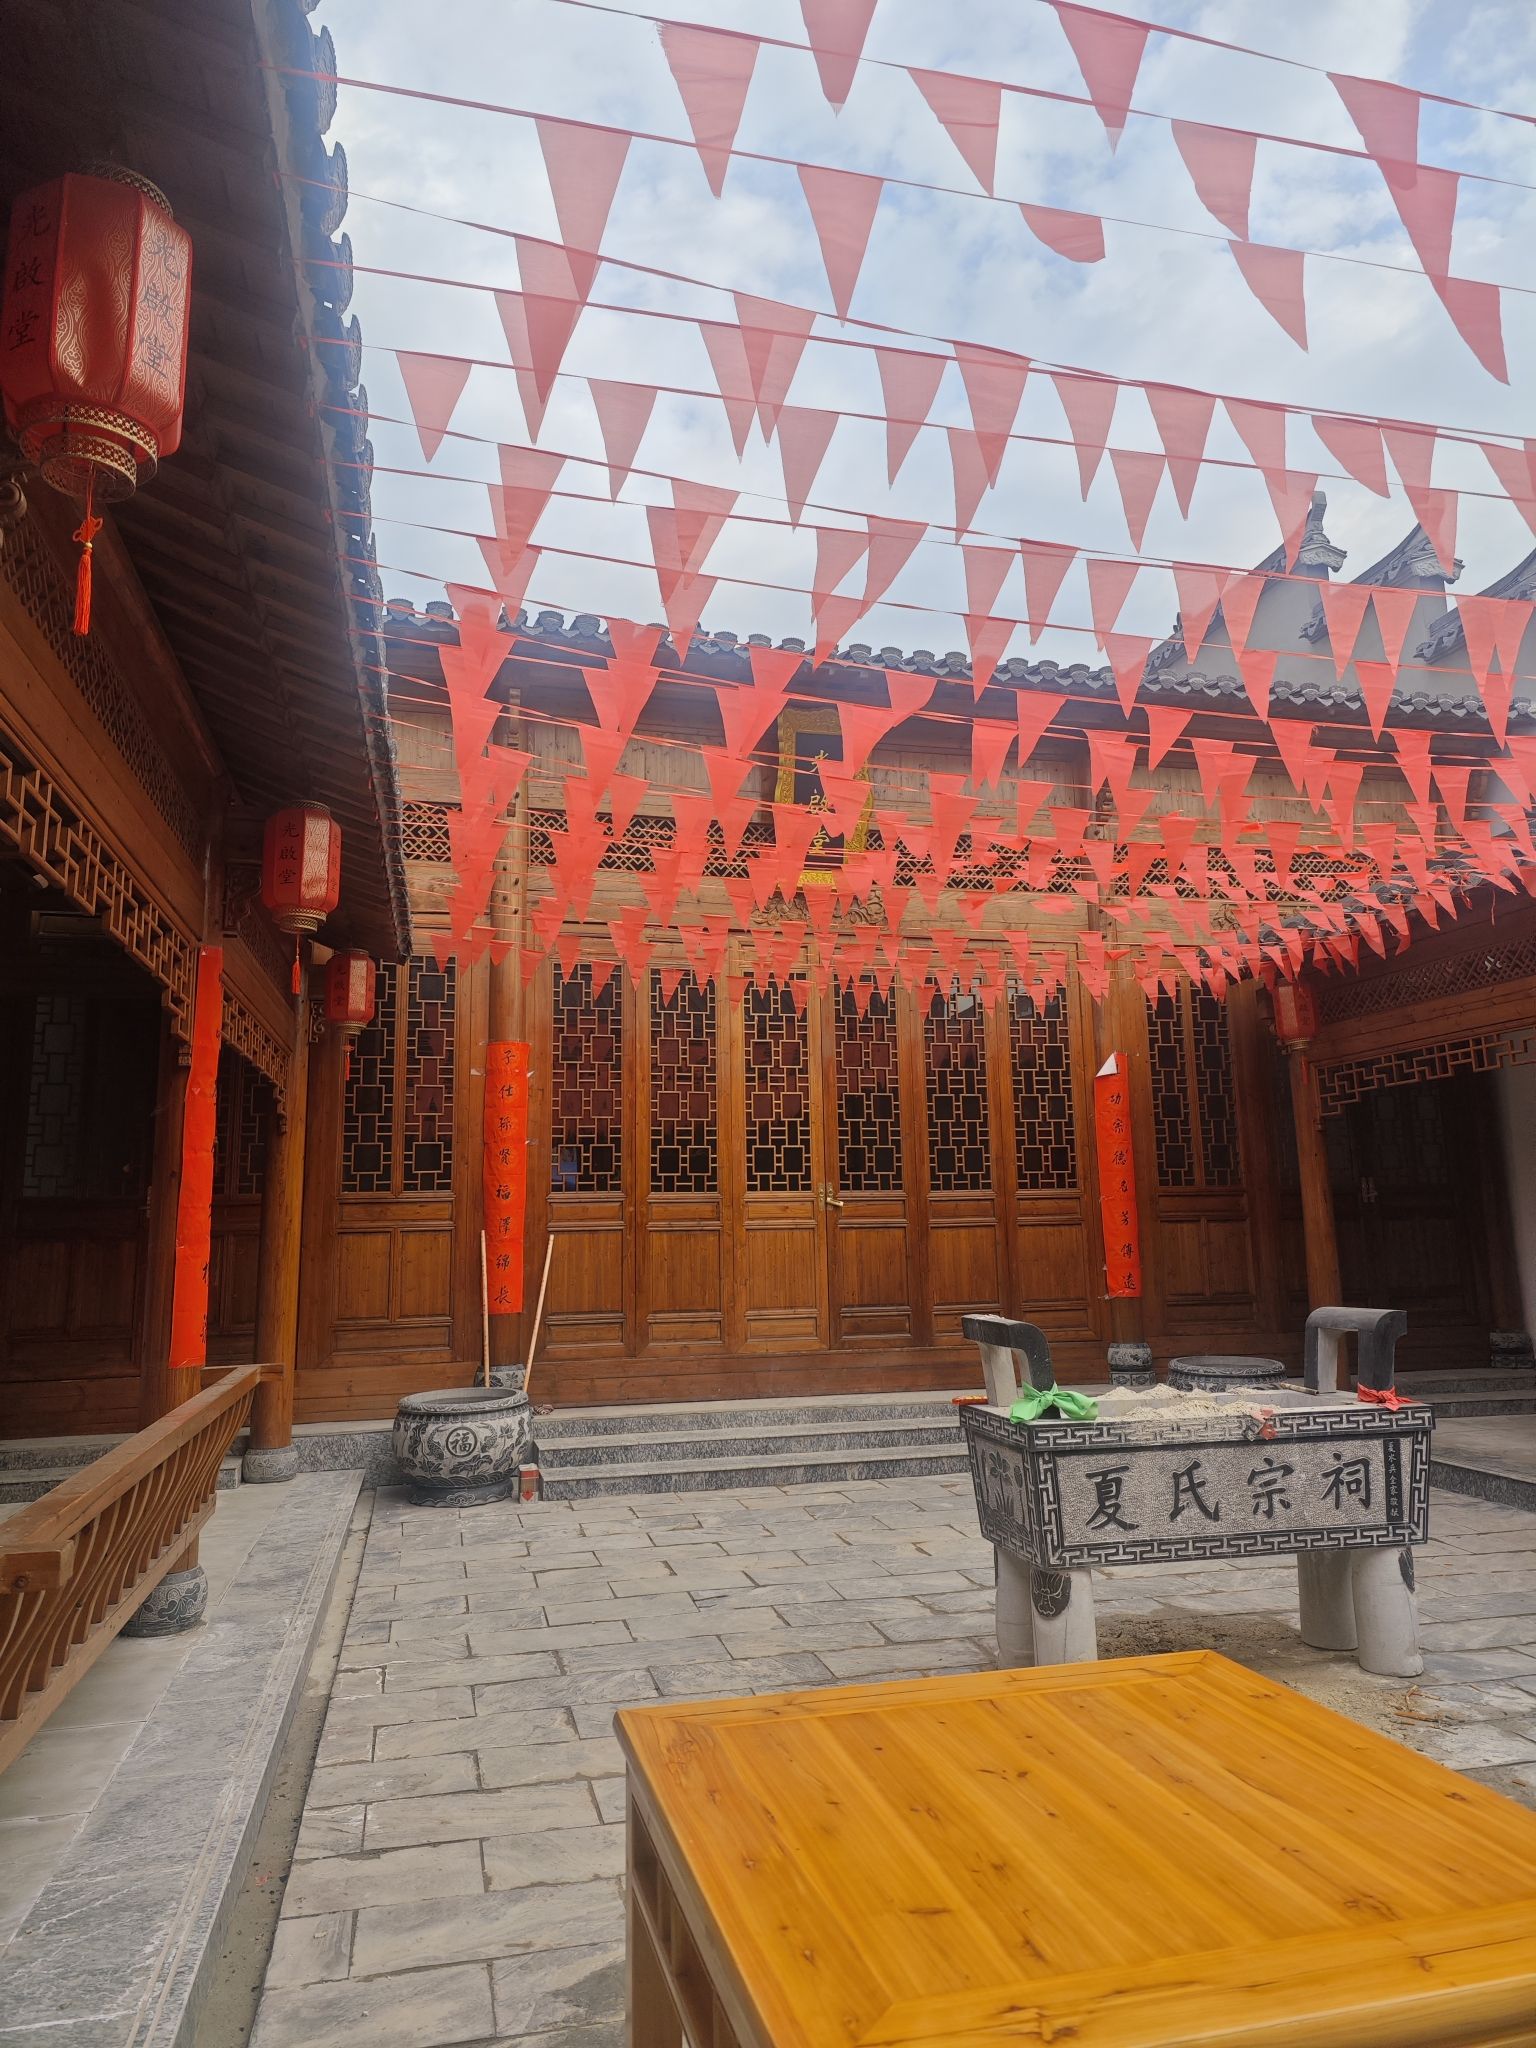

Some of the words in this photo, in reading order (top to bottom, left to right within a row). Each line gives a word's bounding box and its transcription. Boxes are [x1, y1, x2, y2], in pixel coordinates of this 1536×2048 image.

[1110, 1064, 1137, 1290] 功宗德名芳傳遠
[450, 1432, 473, 1453] 福
[1085, 1451, 1373, 1530] 夏氏宗祠
